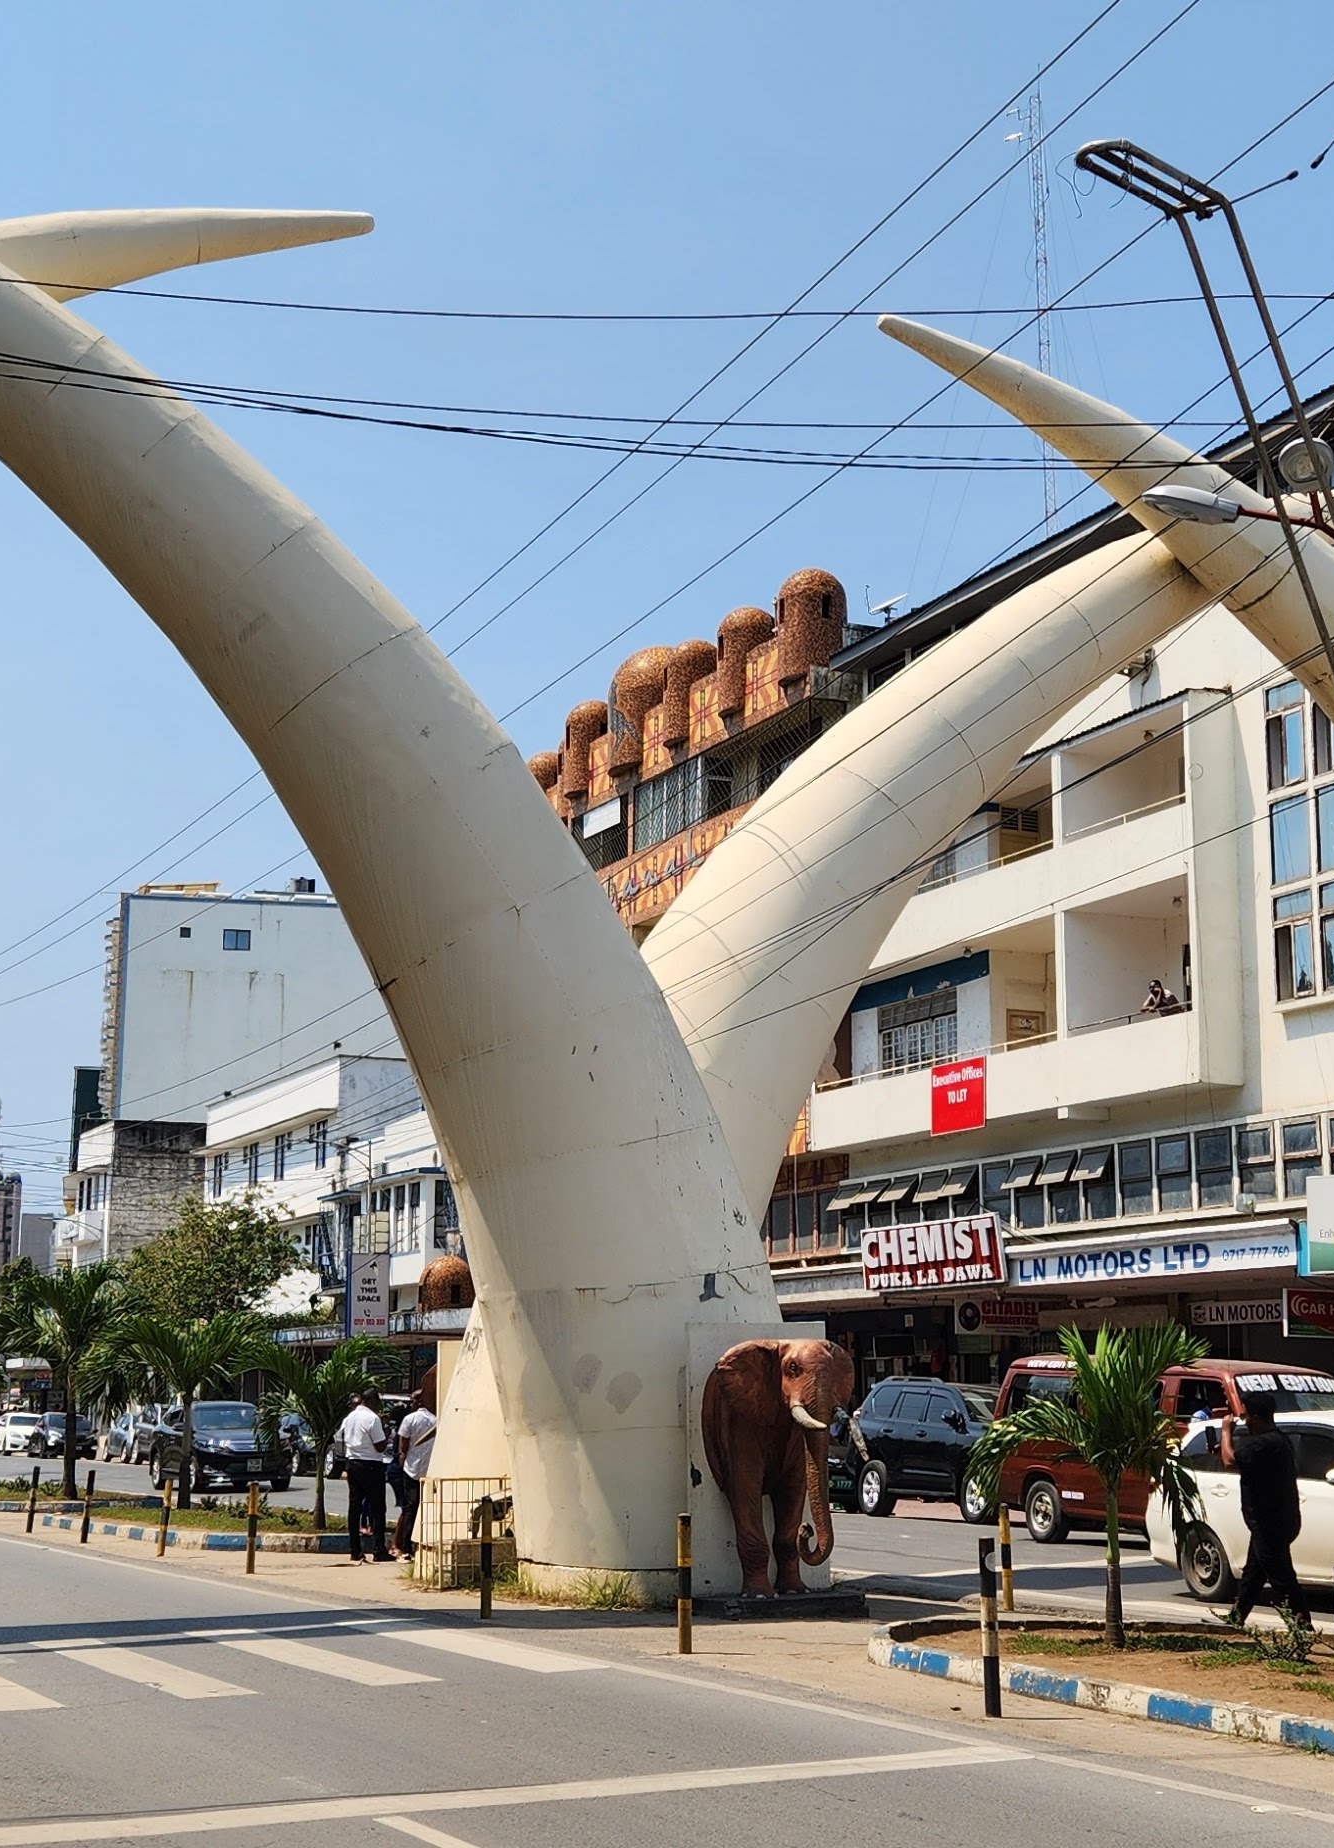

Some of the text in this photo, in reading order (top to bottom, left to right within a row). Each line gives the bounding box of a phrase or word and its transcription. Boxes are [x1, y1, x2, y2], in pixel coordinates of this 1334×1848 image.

[932, 1066, 984, 1088] Executive Offices
[948, 1088, 968, 1104] TO LET
[862, 1218, 993, 1268] CHEMIST
[1019, 1243, 1290, 1282] LN MOTORS LTD 0717 777 760
[869, 1263, 994, 1289] DUKA LA DAWA
[981, 1300, 1039, 1316] CITADEL
[1209, 1303, 1281, 1321] LN MOTORS
[1300, 1302, 1326, 1315] CAR
[1027, 1360, 1049, 1368] NEW
[1236, 1374, 1278, 1392] NEW
